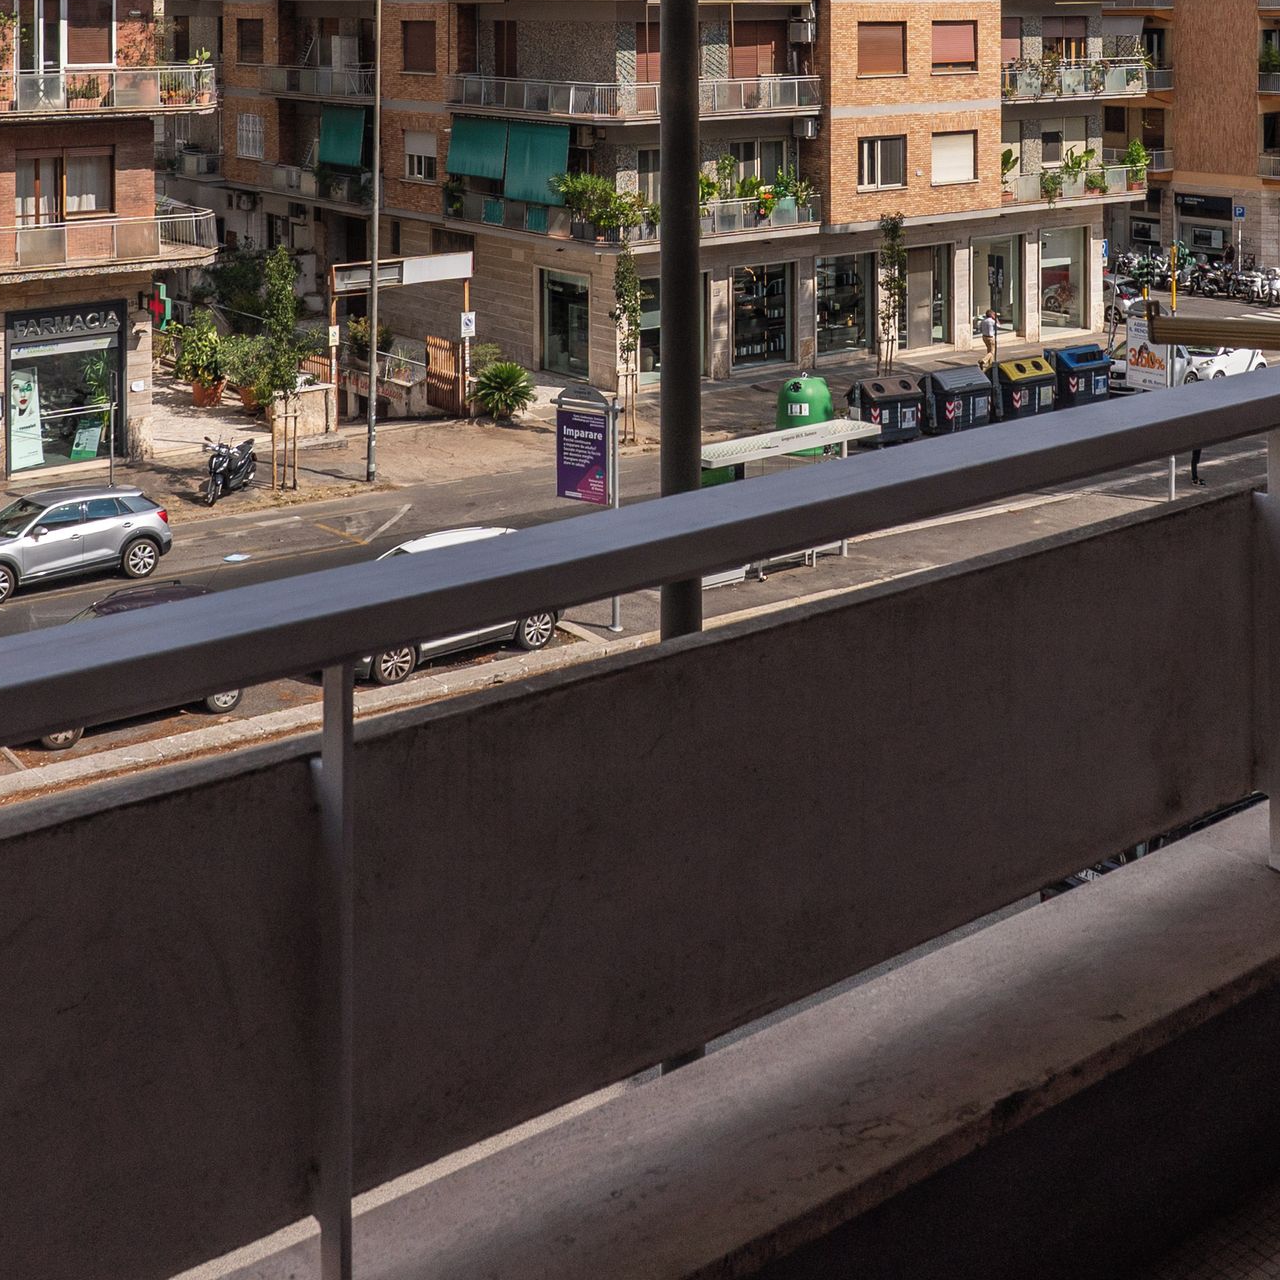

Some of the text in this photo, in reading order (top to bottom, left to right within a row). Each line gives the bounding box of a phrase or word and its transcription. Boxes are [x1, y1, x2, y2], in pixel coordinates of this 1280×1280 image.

[1236, 208, 1243, 217] P
[13, 310, 121, 339] FARMACIA
[563, 425, 603, 440] Imparare
